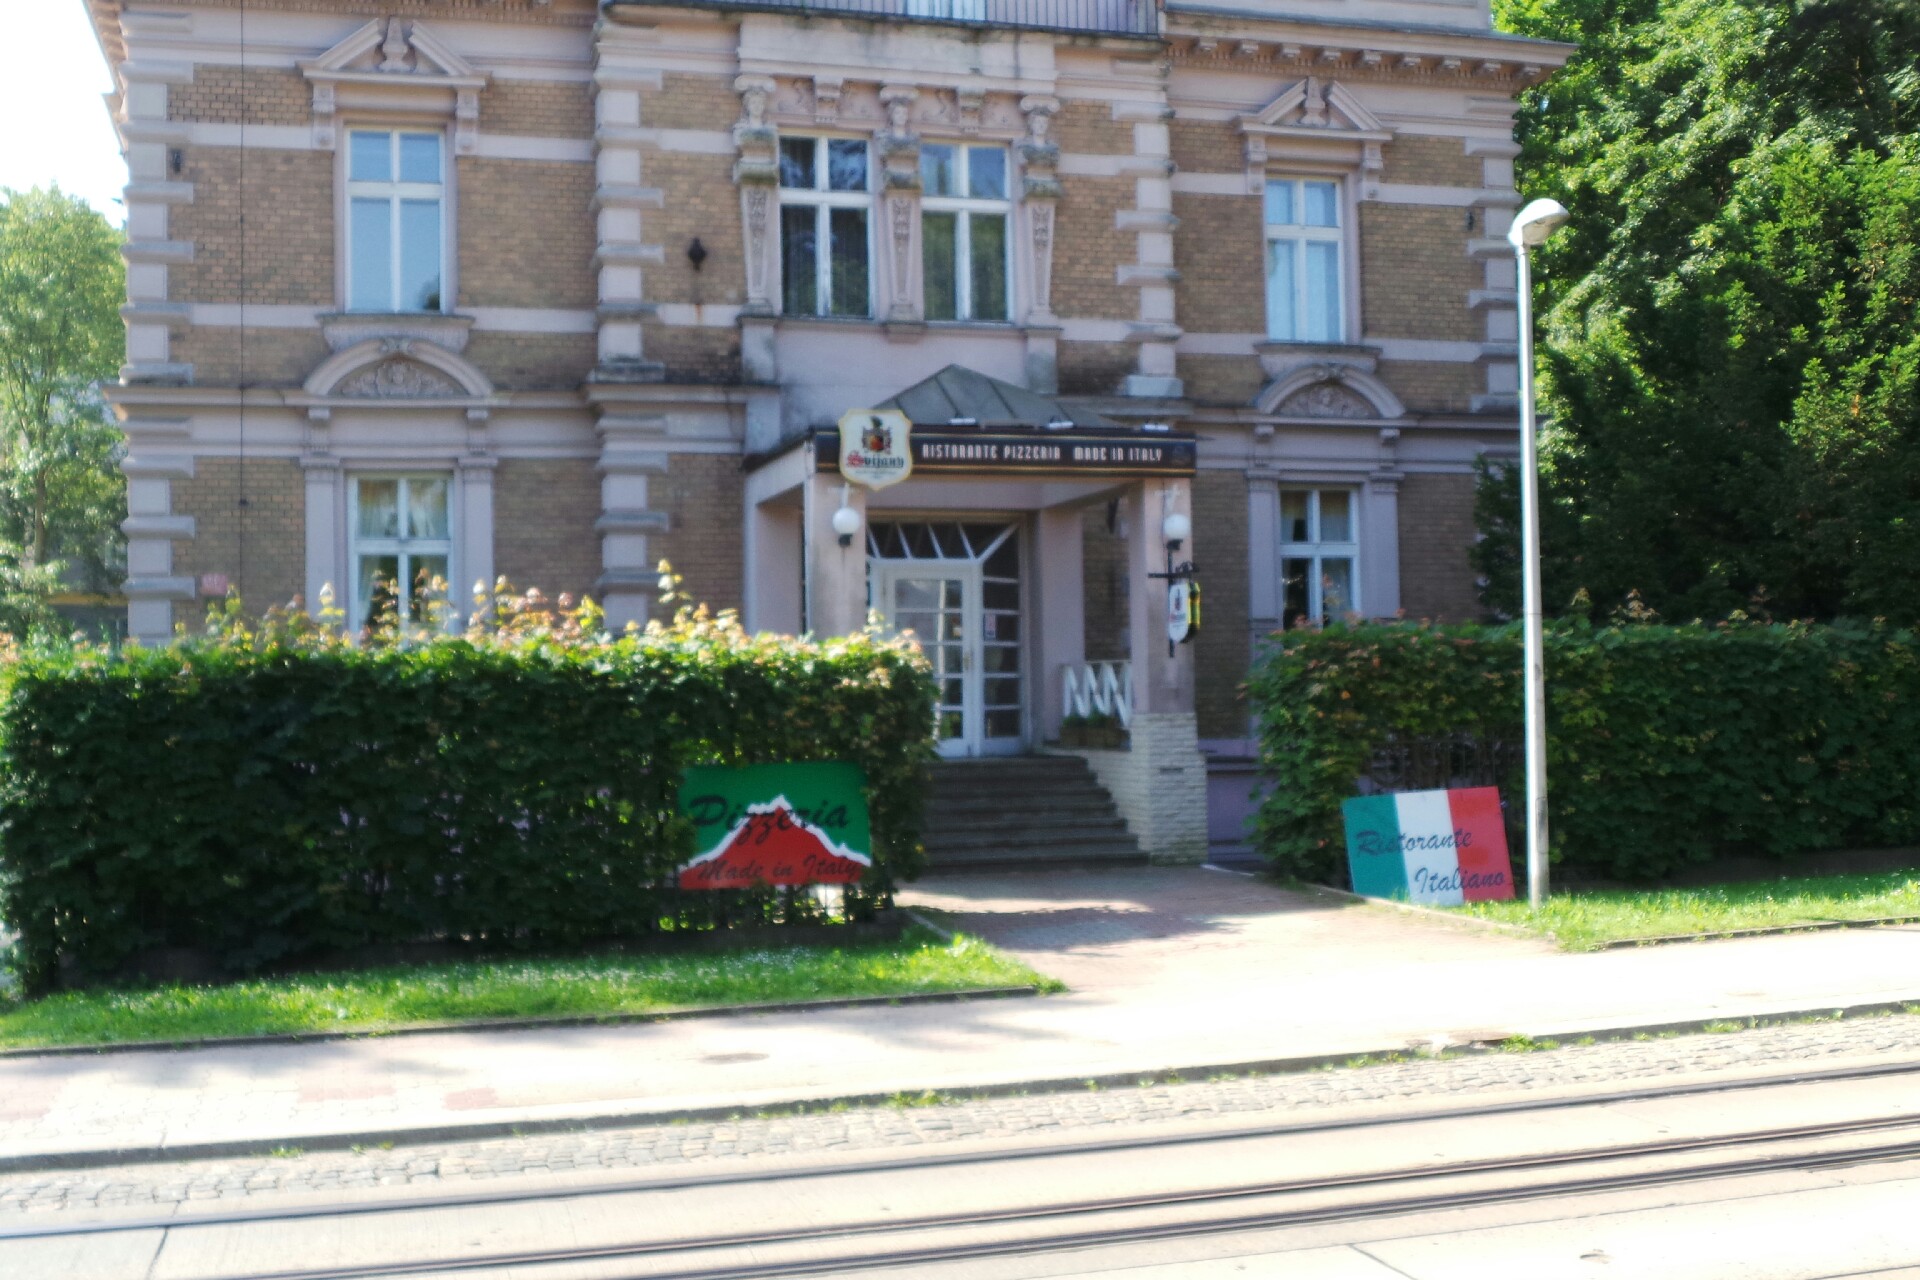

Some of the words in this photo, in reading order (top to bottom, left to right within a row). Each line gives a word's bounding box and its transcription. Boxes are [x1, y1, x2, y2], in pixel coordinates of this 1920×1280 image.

[1004, 446, 1061, 460] PIZZERIA
[1074, 447, 1107, 461] MADE
[1112, 448, 1123, 461] IN
[1129, 448, 1162, 461] ITALY
[1356, 829, 1473, 857] Ristorante
[1414, 867, 1505, 894] Italiano
